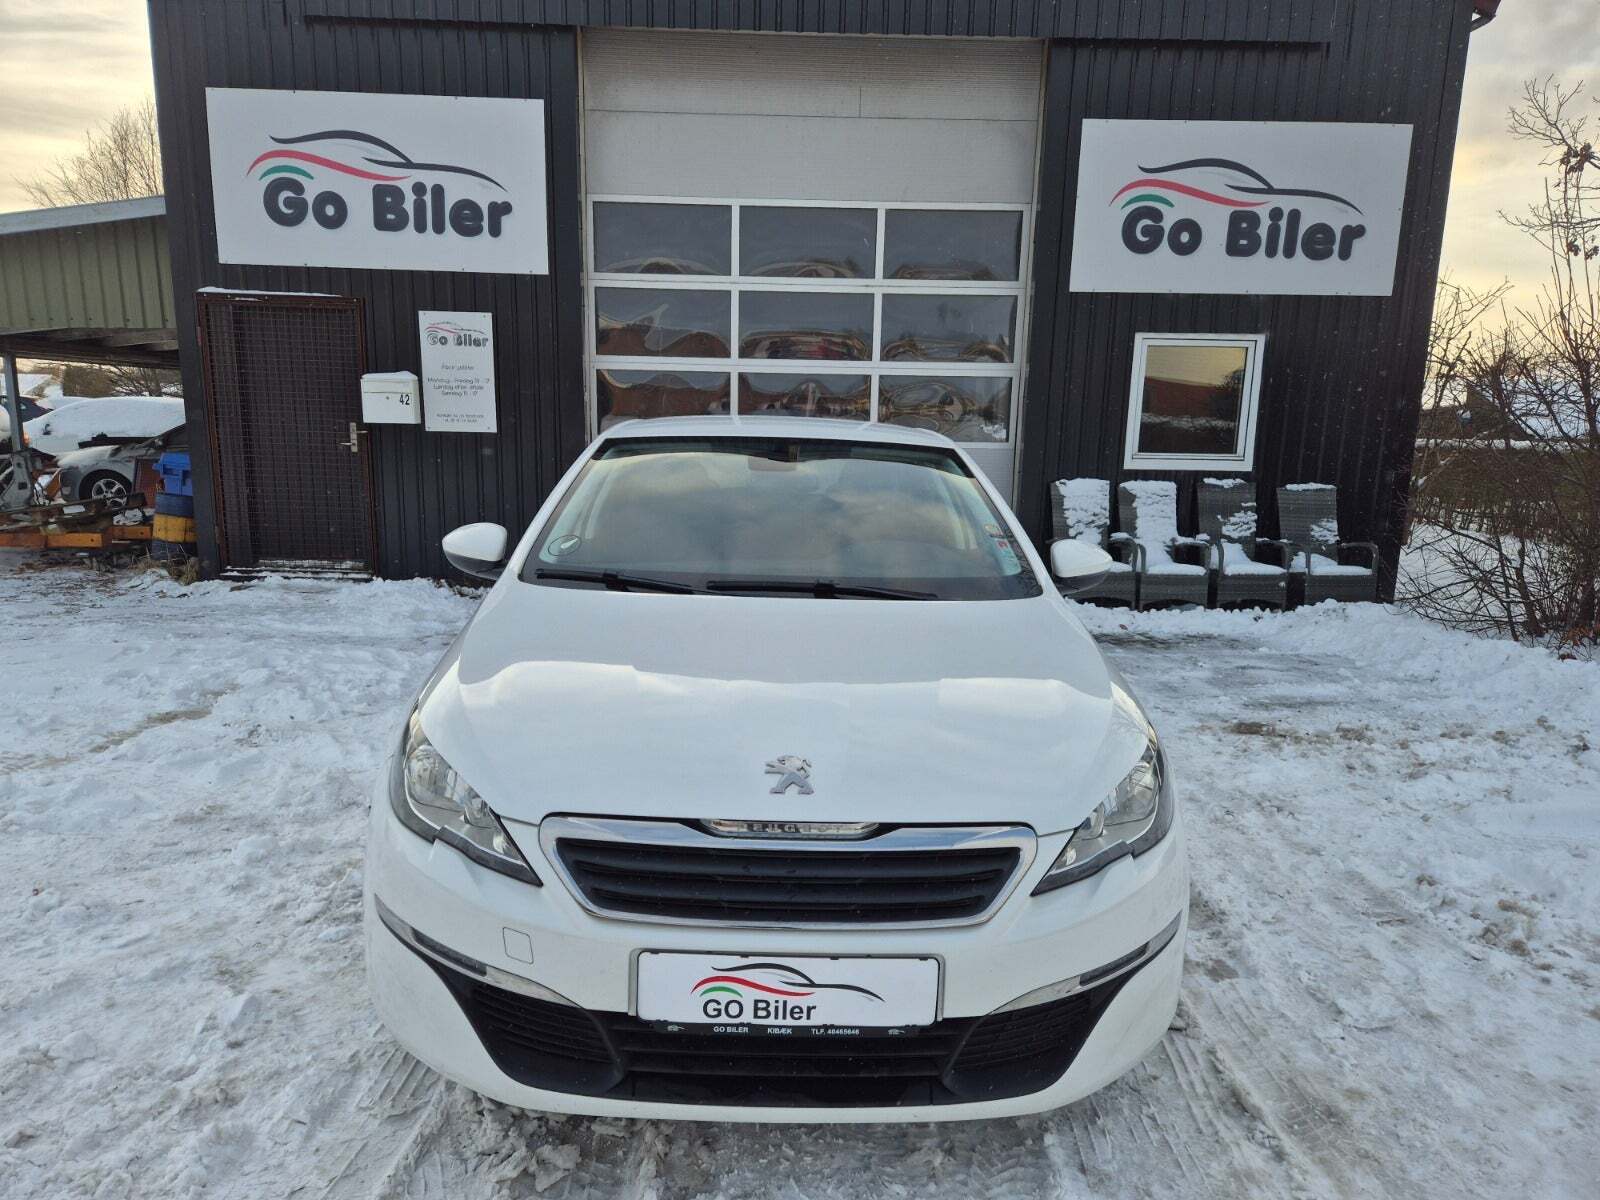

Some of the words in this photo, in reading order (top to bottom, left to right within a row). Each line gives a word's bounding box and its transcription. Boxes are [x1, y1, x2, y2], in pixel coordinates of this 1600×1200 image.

[263, 176, 349, 230] Go
[371, 181, 513, 238] Biler
[1121, 205, 1203, 257] Go
[1224, 206, 1367, 261] Biler
[399, 394, 411, 405] 42
[702, 998, 744, 1020] GO
[753, 998, 817, 1021] Biler
[713, 1025, 727, 1034] GO
